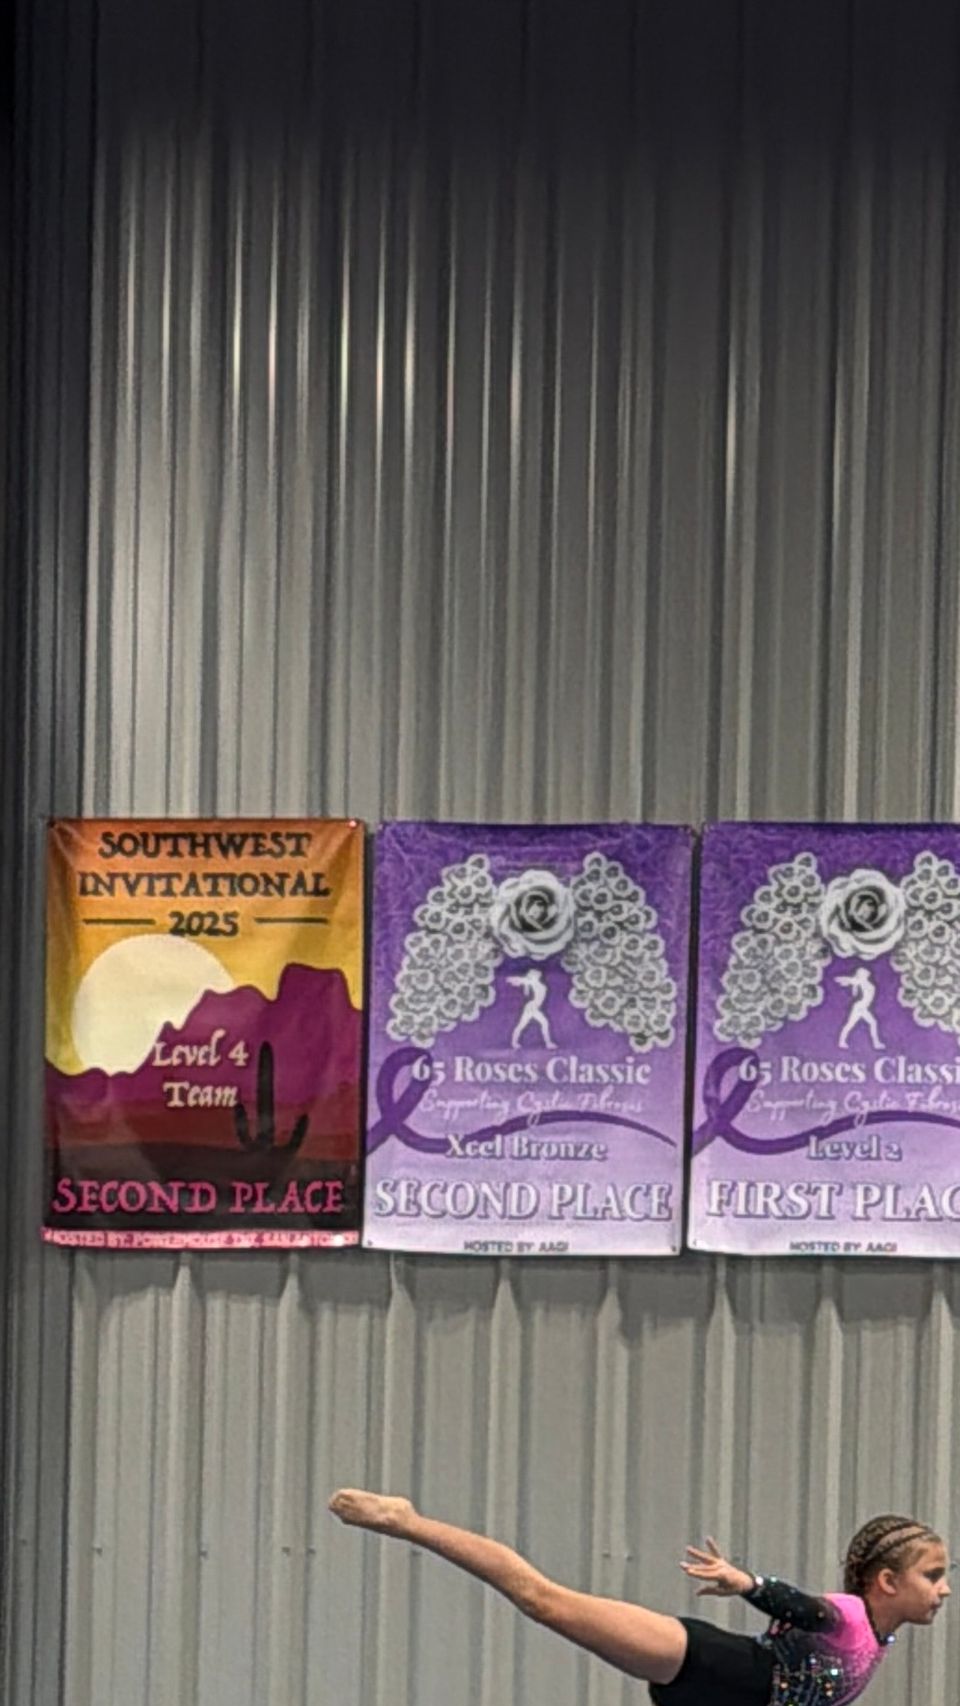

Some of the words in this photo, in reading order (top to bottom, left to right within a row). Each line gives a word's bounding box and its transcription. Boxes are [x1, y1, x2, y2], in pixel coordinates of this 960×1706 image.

[98, 831, 310, 858] SOUTHWEST
[79, 871, 331, 897] INVITATIONAL
[168, 911, 239, 937] 2025
[152, 1029, 225, 1067] Level
[228, 1040, 249, 1067] 4
[412, 1055, 446, 1086] 65
[454, 1055, 539, 1083] Roses
[546, 1055, 651, 1084] Classic
[739, 1055, 773, 1086] 65
[781, 1055, 866, 1083] Roses
[163, 1081, 239, 1108] Team
[447, 1134, 505, 1159] Xcel
[512, 1134, 607, 1161] Bronze
[806, 1135, 881, 1161] Level
[885, 1141, 903, 1161] 2
[52, 1178, 215, 1213] SECOND
[229, 1181, 343, 1213] PLACE
[374, 1180, 539, 1220] SECOND
[549, 1182, 672, 1221] PLACE
[706, 1180, 842, 1219] FIRST
[463, 1241, 513, 1252] HOSTED
[517, 1241, 535, 1252] BY
[790, 1241, 840, 1252] HOSTED
[844, 1241, 862, 1252] BY
